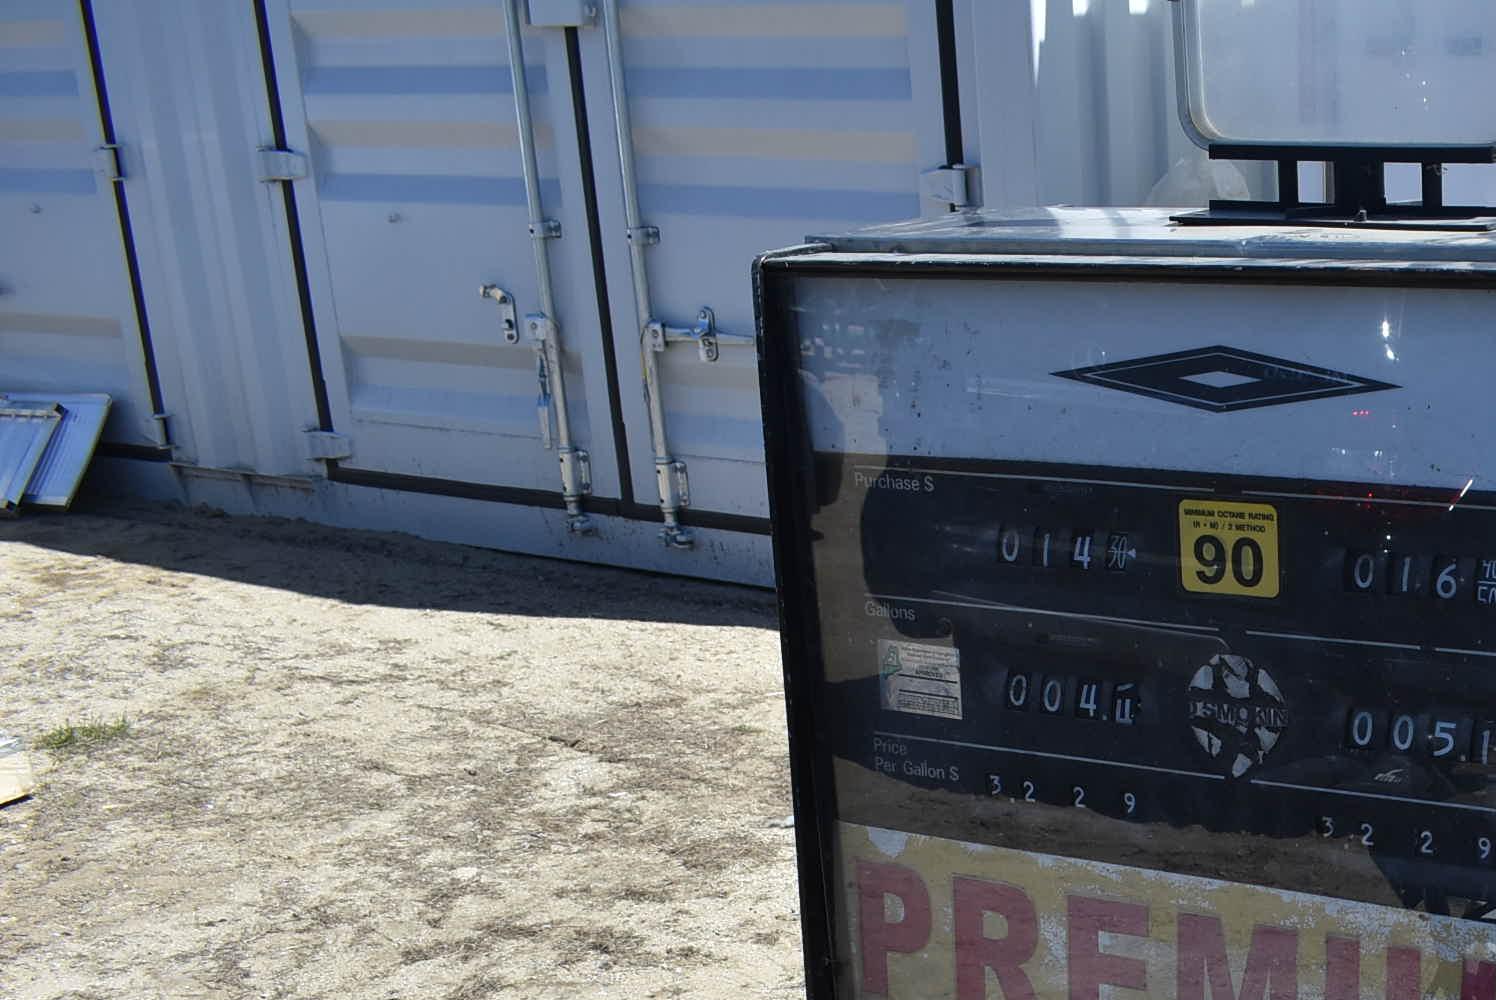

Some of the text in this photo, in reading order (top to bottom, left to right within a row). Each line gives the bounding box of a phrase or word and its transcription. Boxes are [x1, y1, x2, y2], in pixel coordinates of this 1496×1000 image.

[854, 472, 920, 491] Purchase
[1217, 510, 1246, 519] OCTANE
[1248, 513, 1275, 521] RATING
[1234, 524, 1266, 533] METHOD
[1193, 534, 1264, 588] 90
[864, 600, 916, 622] Gallons
[873, 737, 907, 755] Price
[874, 756, 896, 772] Per
[903, 760, 945, 779] Gallon
